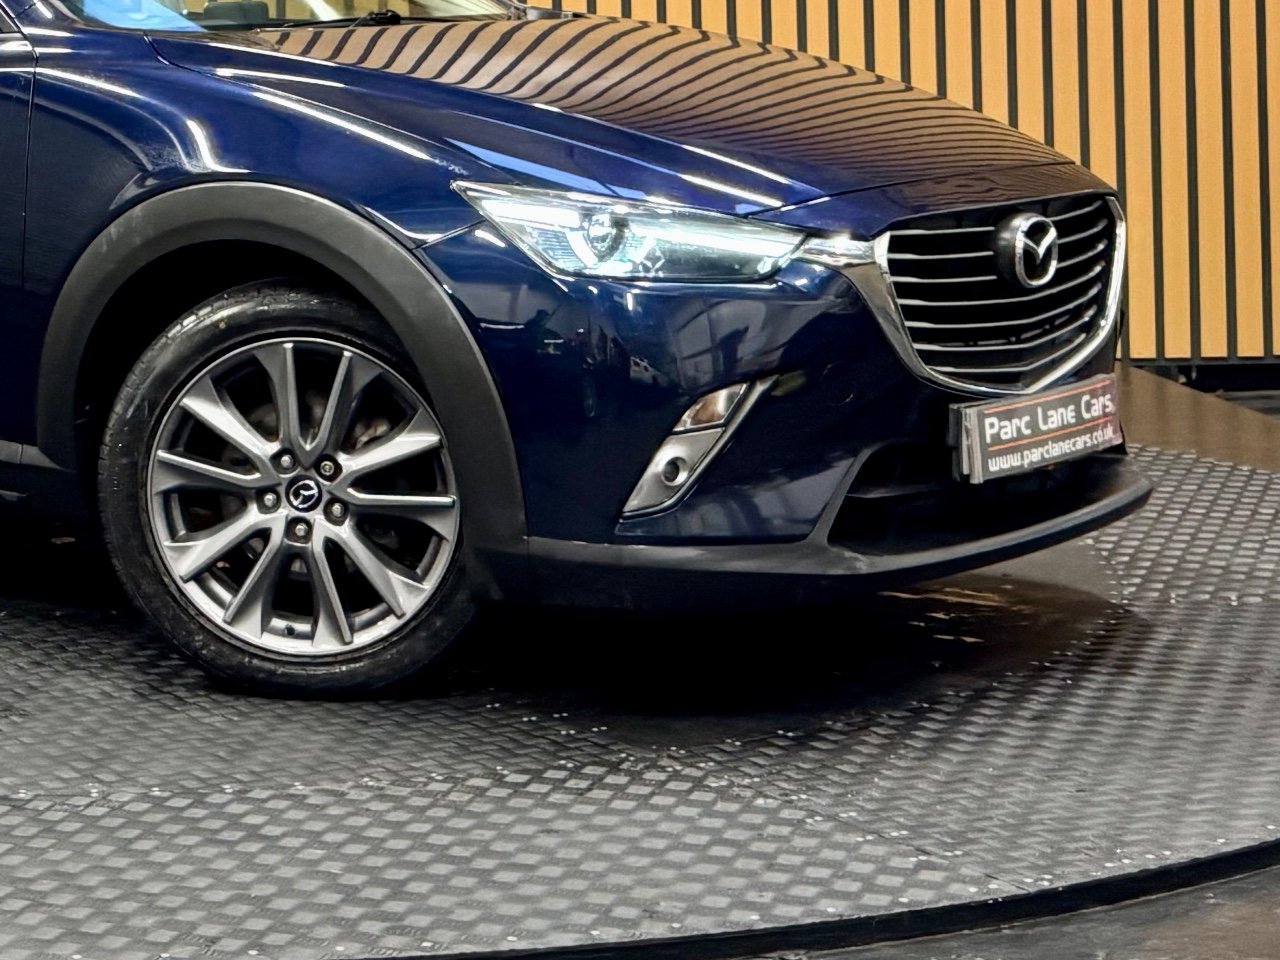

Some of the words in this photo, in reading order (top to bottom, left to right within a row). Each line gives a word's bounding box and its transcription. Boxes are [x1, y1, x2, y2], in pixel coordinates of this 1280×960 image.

[984, 414, 1032, 444] Parc
[1037, 404, 1076, 431] Lane
[987, 423, 1114, 471] www.parclanecars.co.uk
